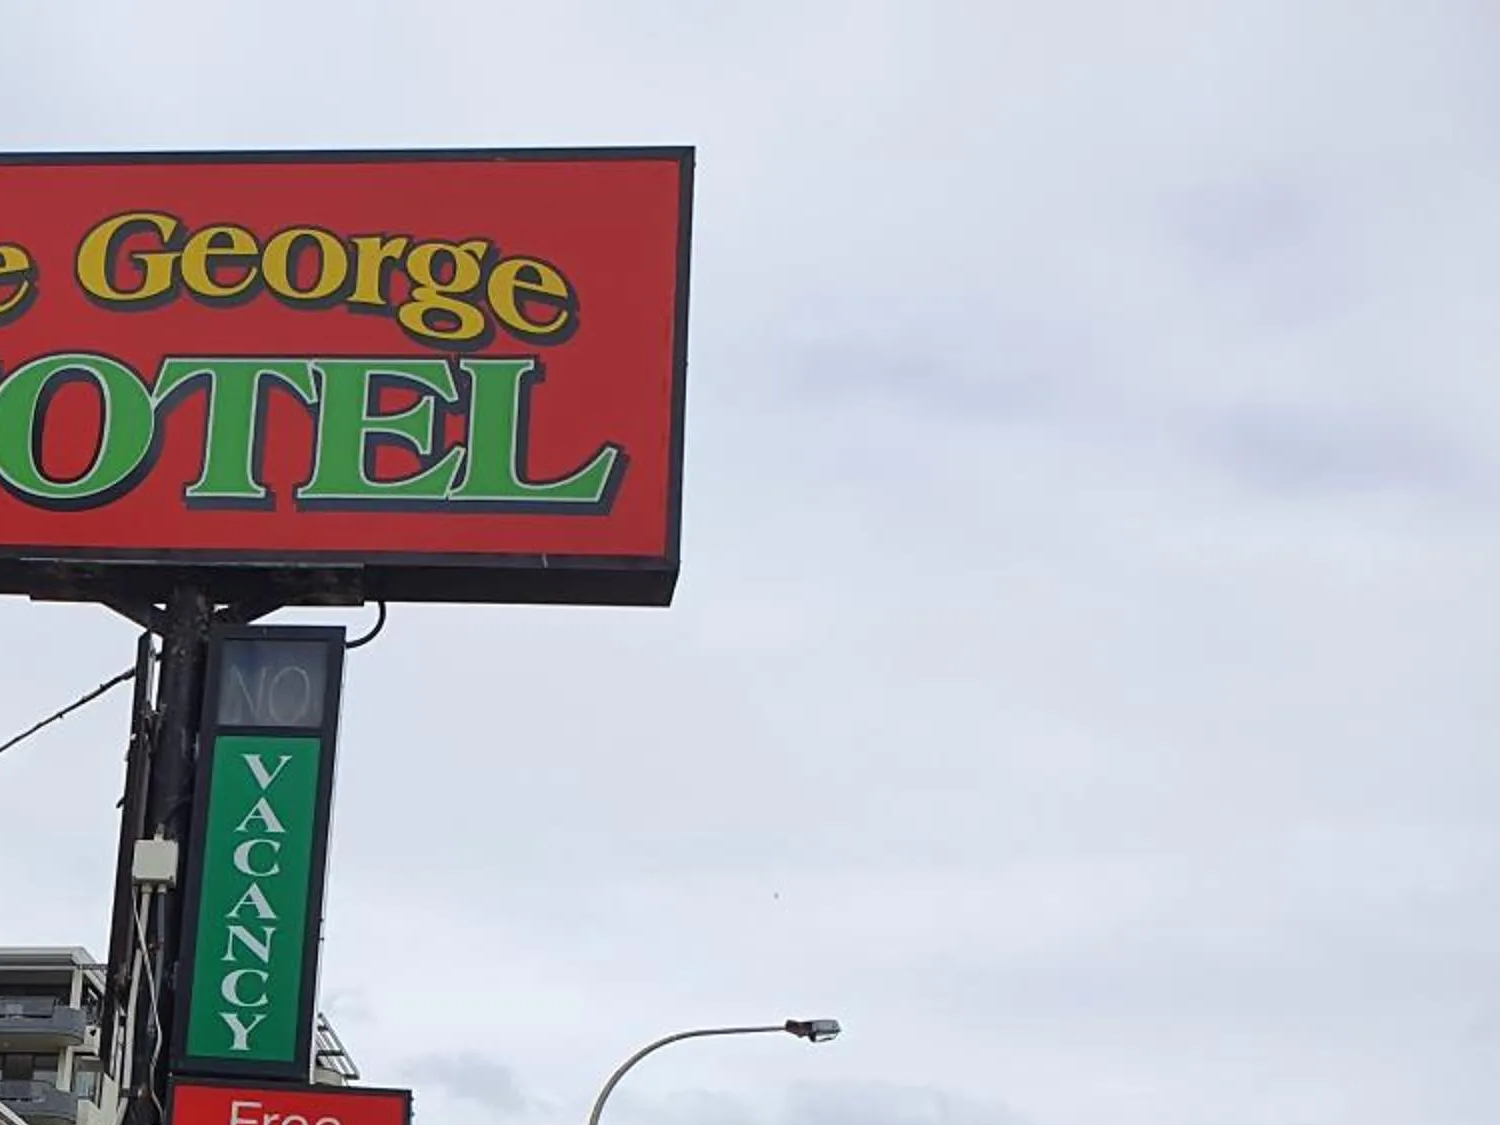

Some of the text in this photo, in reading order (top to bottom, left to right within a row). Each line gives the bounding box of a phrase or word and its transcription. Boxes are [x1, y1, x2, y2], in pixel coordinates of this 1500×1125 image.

[74, 210, 574, 346] George
[222, 664, 310, 724] NO
[220, 752, 292, 1052] VACANCY
